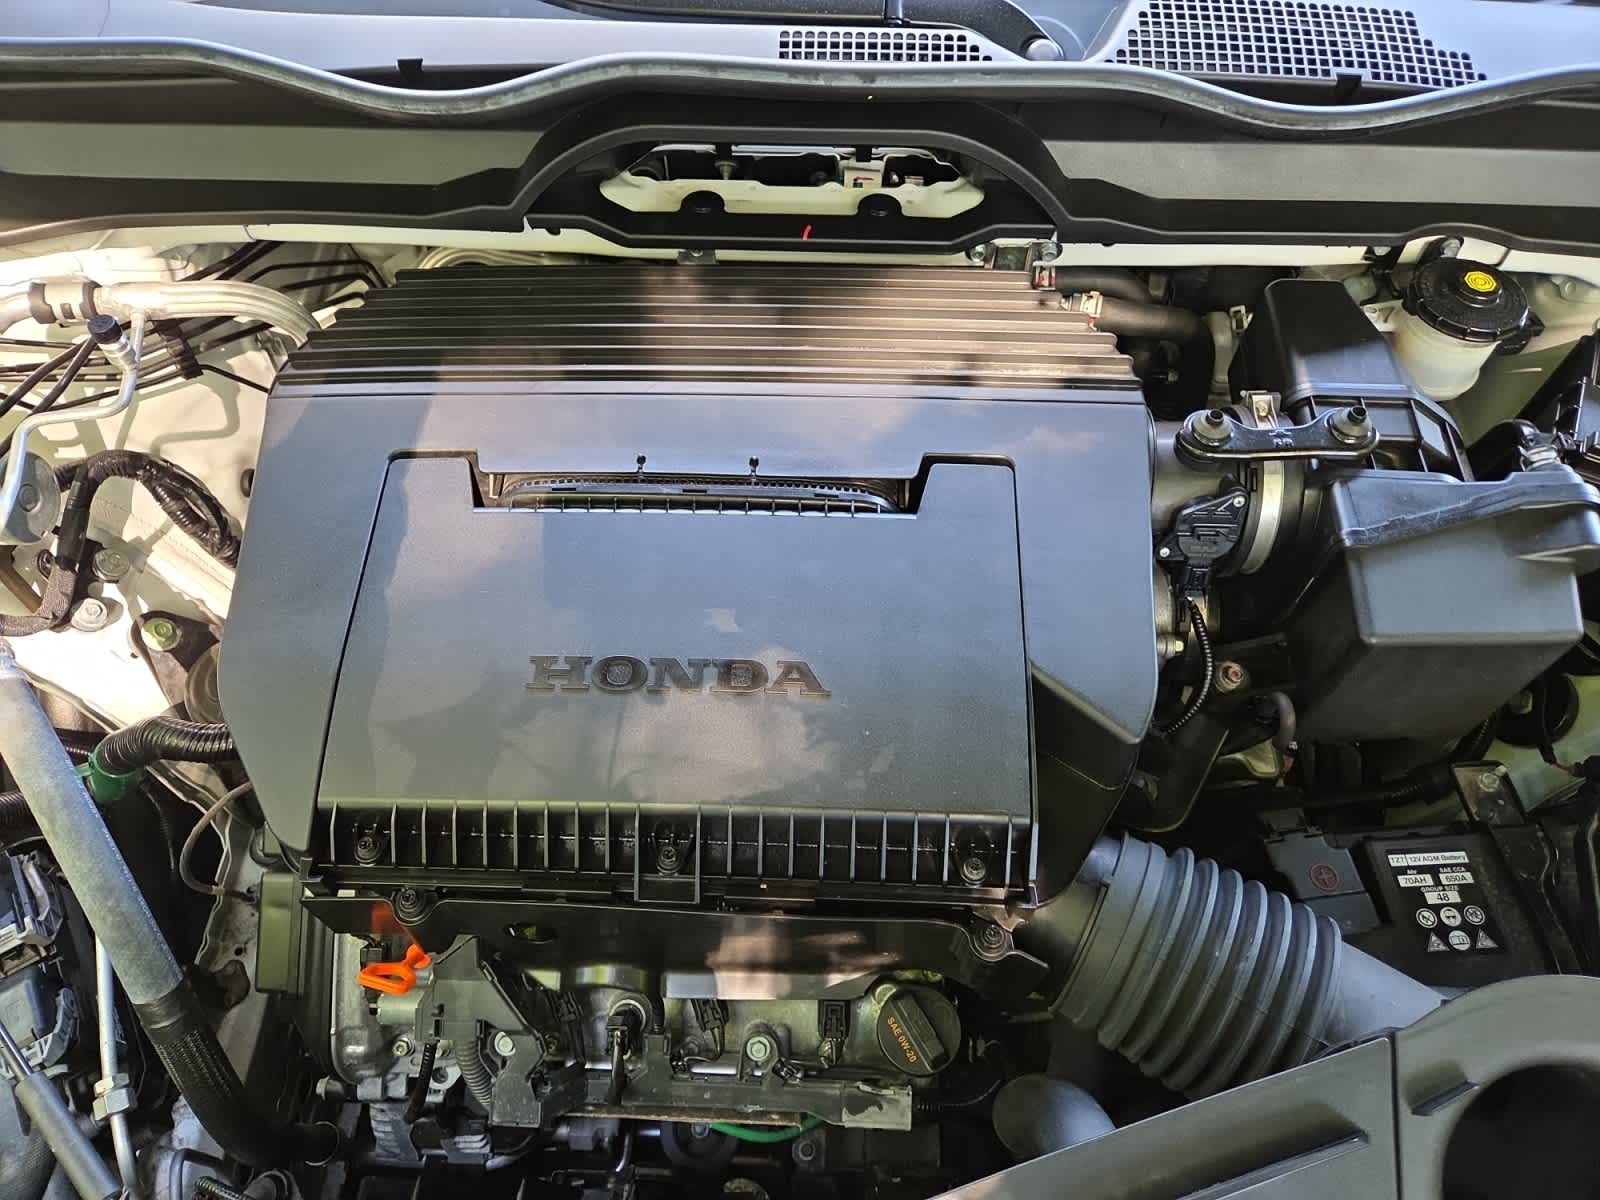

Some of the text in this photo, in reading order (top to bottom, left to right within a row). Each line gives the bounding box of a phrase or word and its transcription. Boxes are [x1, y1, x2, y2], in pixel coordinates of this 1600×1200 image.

[526, 655, 832, 696] HONDA
[1440, 853, 1465, 863] Battery
[1402, 876, 1427, 885] 70AH
[1445, 874, 1468, 883] 650A
[1437, 892, 1450, 902] 48
[887, 1016, 918, 1062] SAE 0W-20
